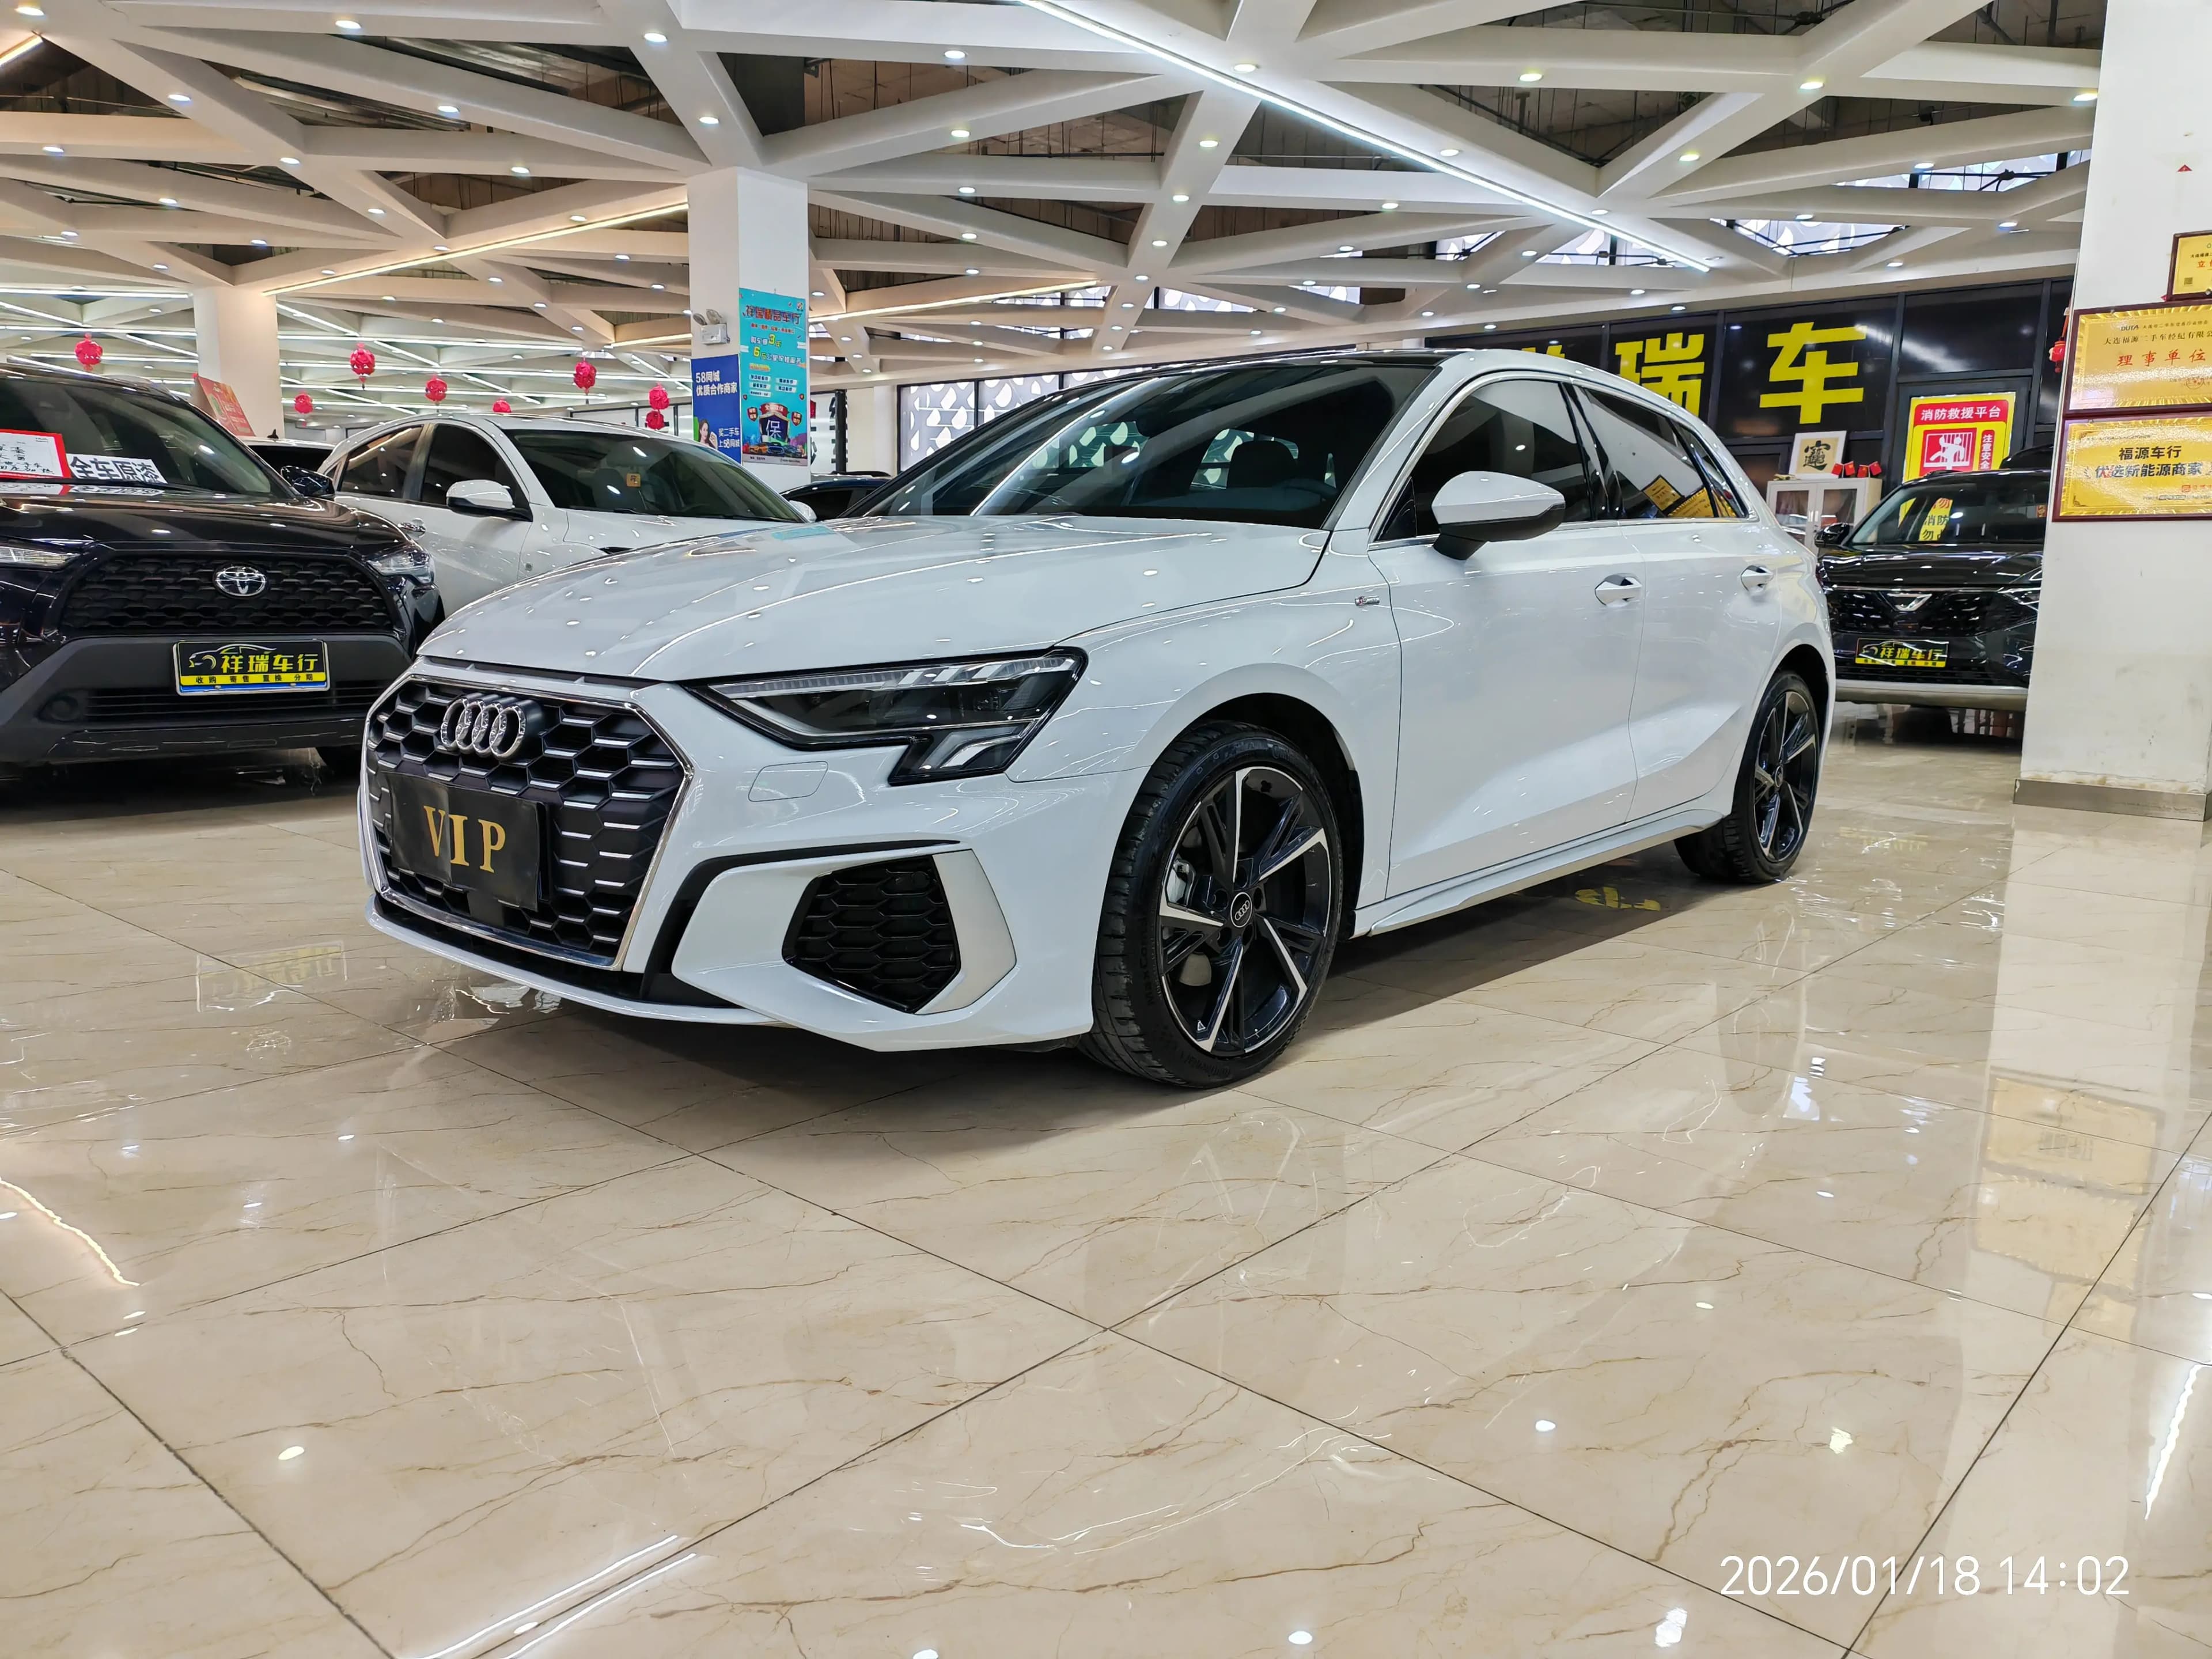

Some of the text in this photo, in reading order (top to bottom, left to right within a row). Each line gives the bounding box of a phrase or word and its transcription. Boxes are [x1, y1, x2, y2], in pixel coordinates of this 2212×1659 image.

[2116, 349, 2206, 367] 理事单位
[696, 370, 719, 383] 58同城
[696, 382, 737, 396] 优质合作商家
[1921, 406, 2001, 421] 消防救援平台
[1980, 434, 1993, 469] 注意安全
[2119, 446, 2181, 460] 福源车行
[70, 456, 160, 483] 全车原漆
[2095, 462, 2203, 478] 优选新能源商家
[1880, 647, 1943, 661] 祥瑞车行
[221, 654, 318, 673] 祥瑞车行
[423, 805, 506, 873] VIP
